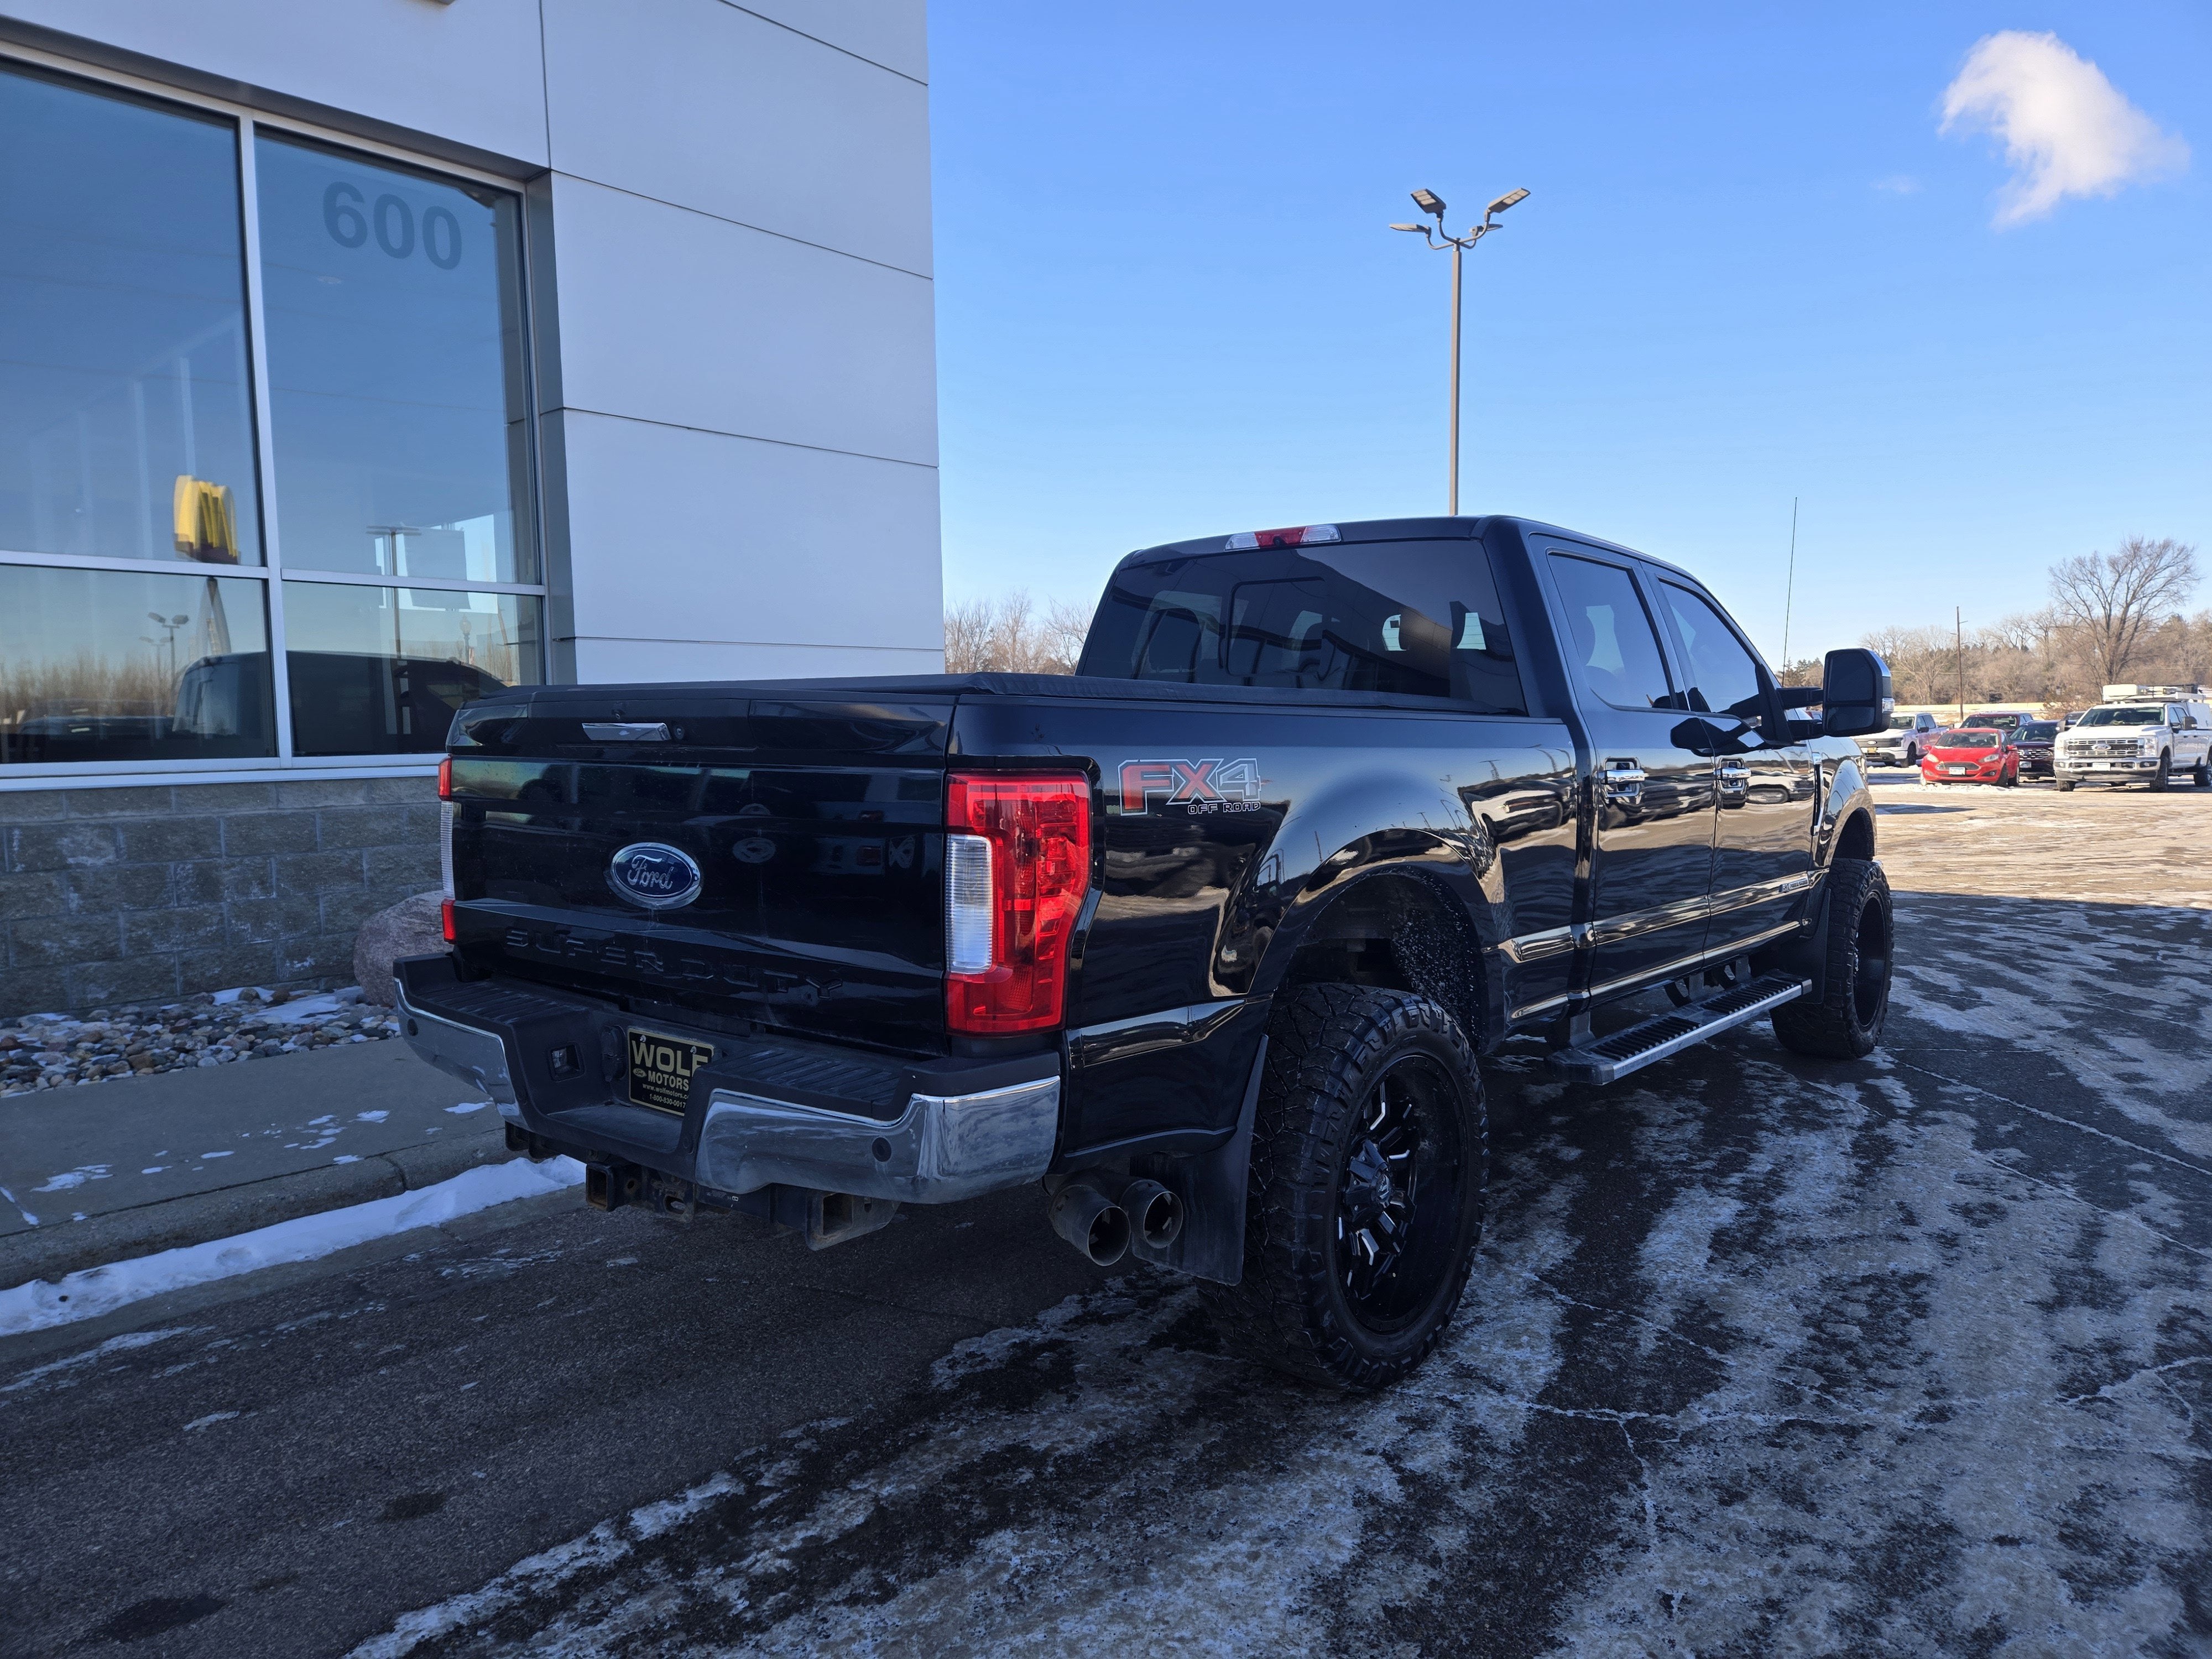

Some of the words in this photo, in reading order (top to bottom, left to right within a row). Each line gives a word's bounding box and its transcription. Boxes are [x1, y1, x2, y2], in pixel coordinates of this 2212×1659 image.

[323, 181, 462, 270] 600
[1118, 758, 1261, 816] FX4
[1187, 803, 1218, 815] OFF
[1223, 801, 1261, 812] ROAD
[627, 854, 673, 889] Ford
[504, 927, 664, 972] SUPER
[680, 957, 843, 999] DUTY
[632, 1040, 708, 1077] WOLF
[643, 1083, 688, 1099] www.wolfmotors.c
[648, 1070, 689, 1091] MOTORS
[649, 1093, 686, 1108] 1-800-830-0017
